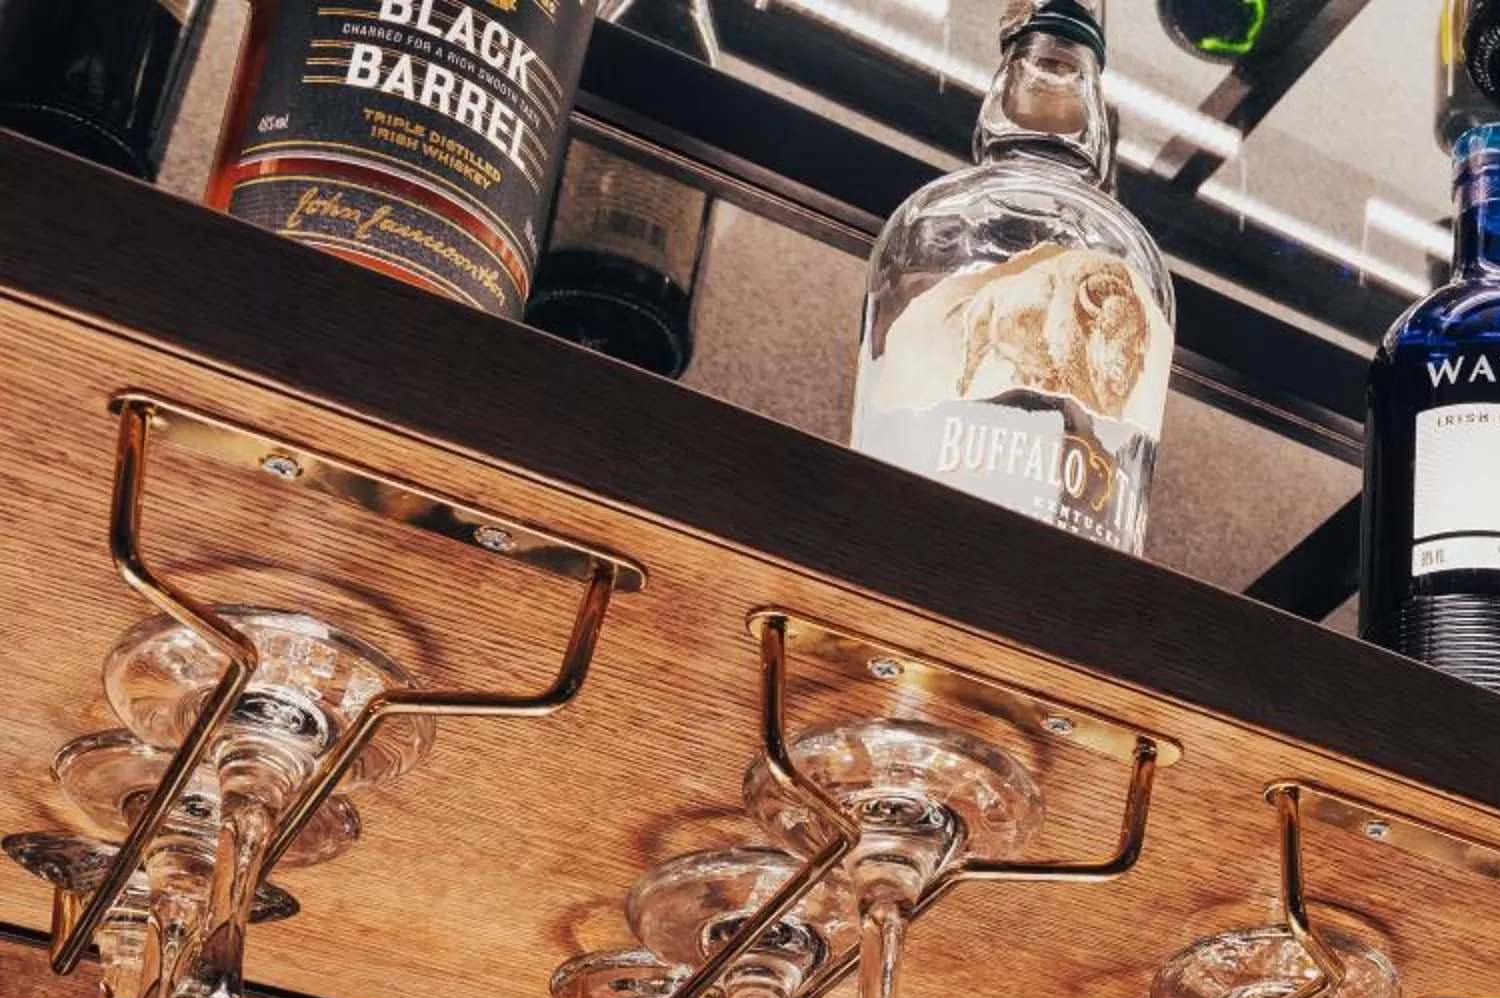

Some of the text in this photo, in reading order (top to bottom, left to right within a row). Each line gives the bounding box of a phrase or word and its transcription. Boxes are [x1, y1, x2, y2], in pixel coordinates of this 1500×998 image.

[342, 22, 403, 43] CHARRED
[406, 35, 431, 53] FOR
[435, 47, 443, 59] A
[447, 51, 476, 74] RICH
[477, 66, 519, 105] SMOOTH
[379, 0, 536, 94] BLACK
[346, 42, 526, 170] BARREL
[362, 107, 501, 184] TRIPLE DISTILLED
[371, 126, 491, 190] IRISH WHISKEY
[938, 416, 1087, 499] BUFFALO
[1437, 413, 1489, 428] IRISH
